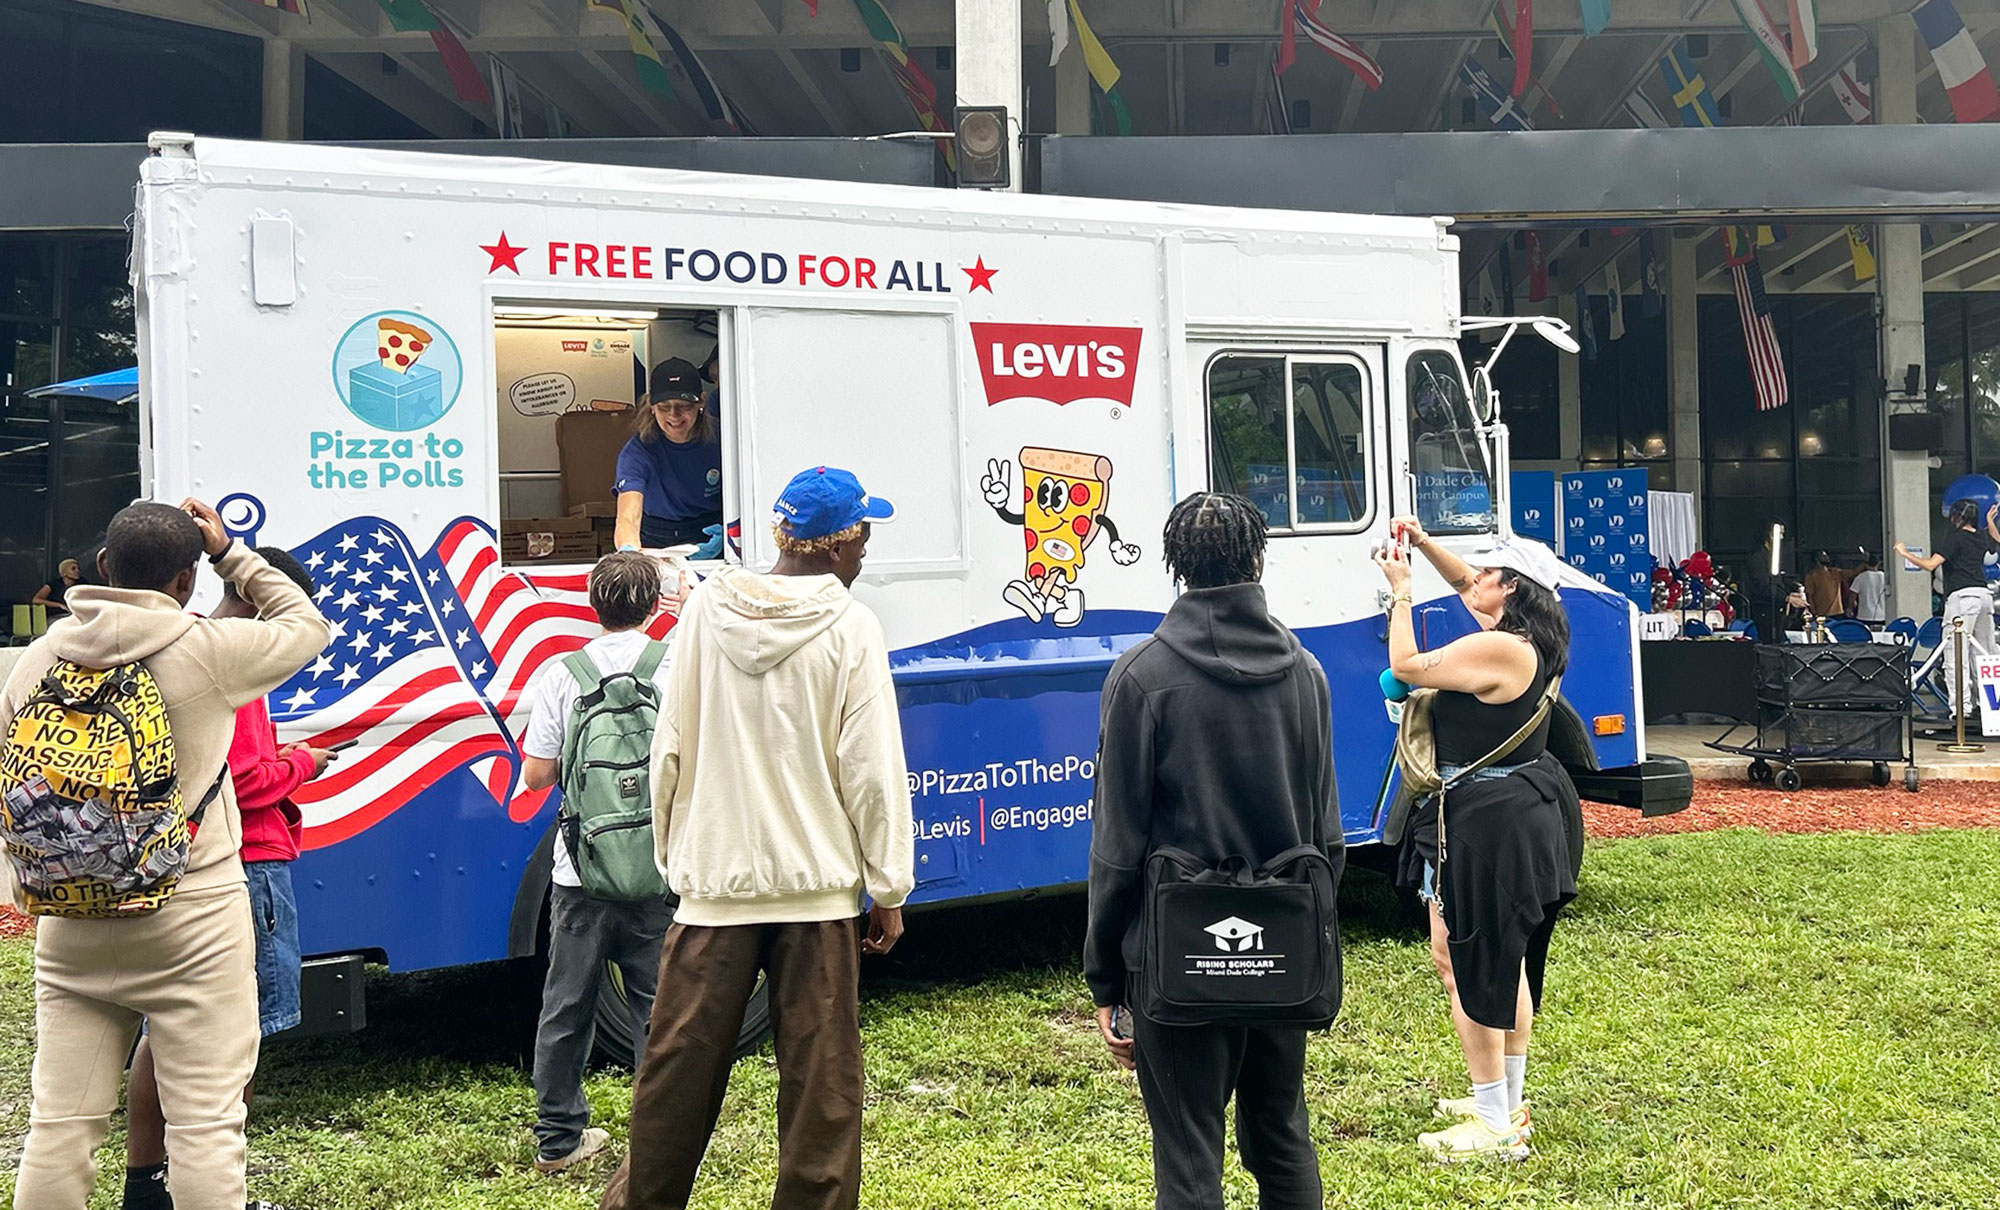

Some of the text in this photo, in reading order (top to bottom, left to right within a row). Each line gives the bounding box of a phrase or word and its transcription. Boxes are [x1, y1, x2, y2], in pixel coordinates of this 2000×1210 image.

[548, 241, 951, 293] FREE FOOD FOR ALL
[310, 430, 464, 459] Pizza to
[307, 460, 464, 489] the Polls
[1425, 475, 1459, 487] Dade
[1415, 490, 1485, 503] orth Campus
[778, 500, 798, 516] ANCE
[1647, 622, 1664, 632] LIT
[34, 723, 78, 746] NO
[907, 754, 1100, 797] @PizzaToThePo
[59, 777, 100, 801] NO
[1228, 960, 1275, 968] SCHOLARS
[1243, 969, 1265, 977] College
